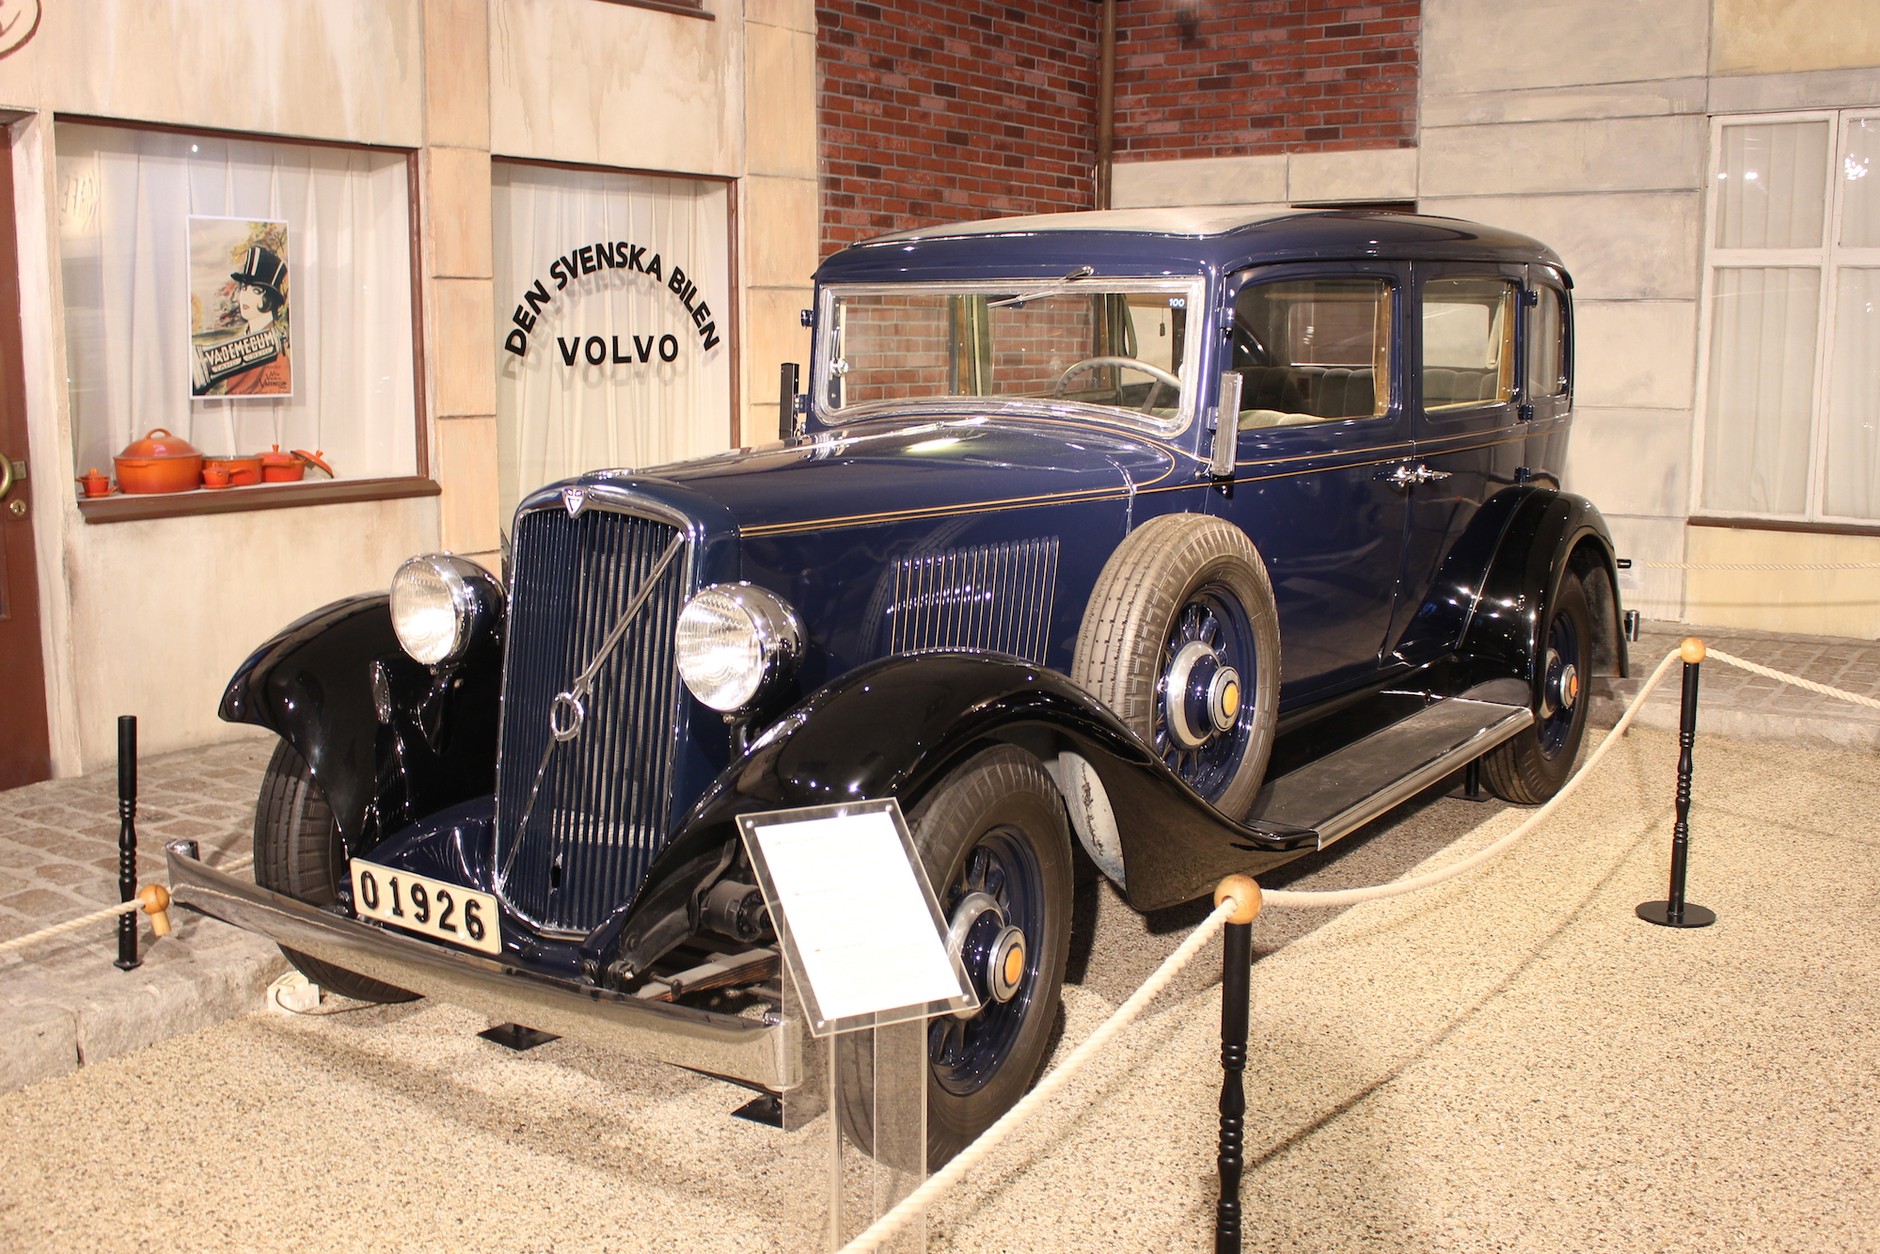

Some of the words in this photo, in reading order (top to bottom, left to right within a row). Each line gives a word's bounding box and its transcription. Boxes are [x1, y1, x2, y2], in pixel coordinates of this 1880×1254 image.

[505, 280, 551, 356] DEN
[550, 242, 661, 290] SVENSKA
[669, 267, 719, 350] BILEN
[1169, 298, 1185, 307] 100
[205, 332, 274, 365] VADEMECUM
[557, 335, 678, 366] VOLVO
[361, 871, 484, 940] 01926
